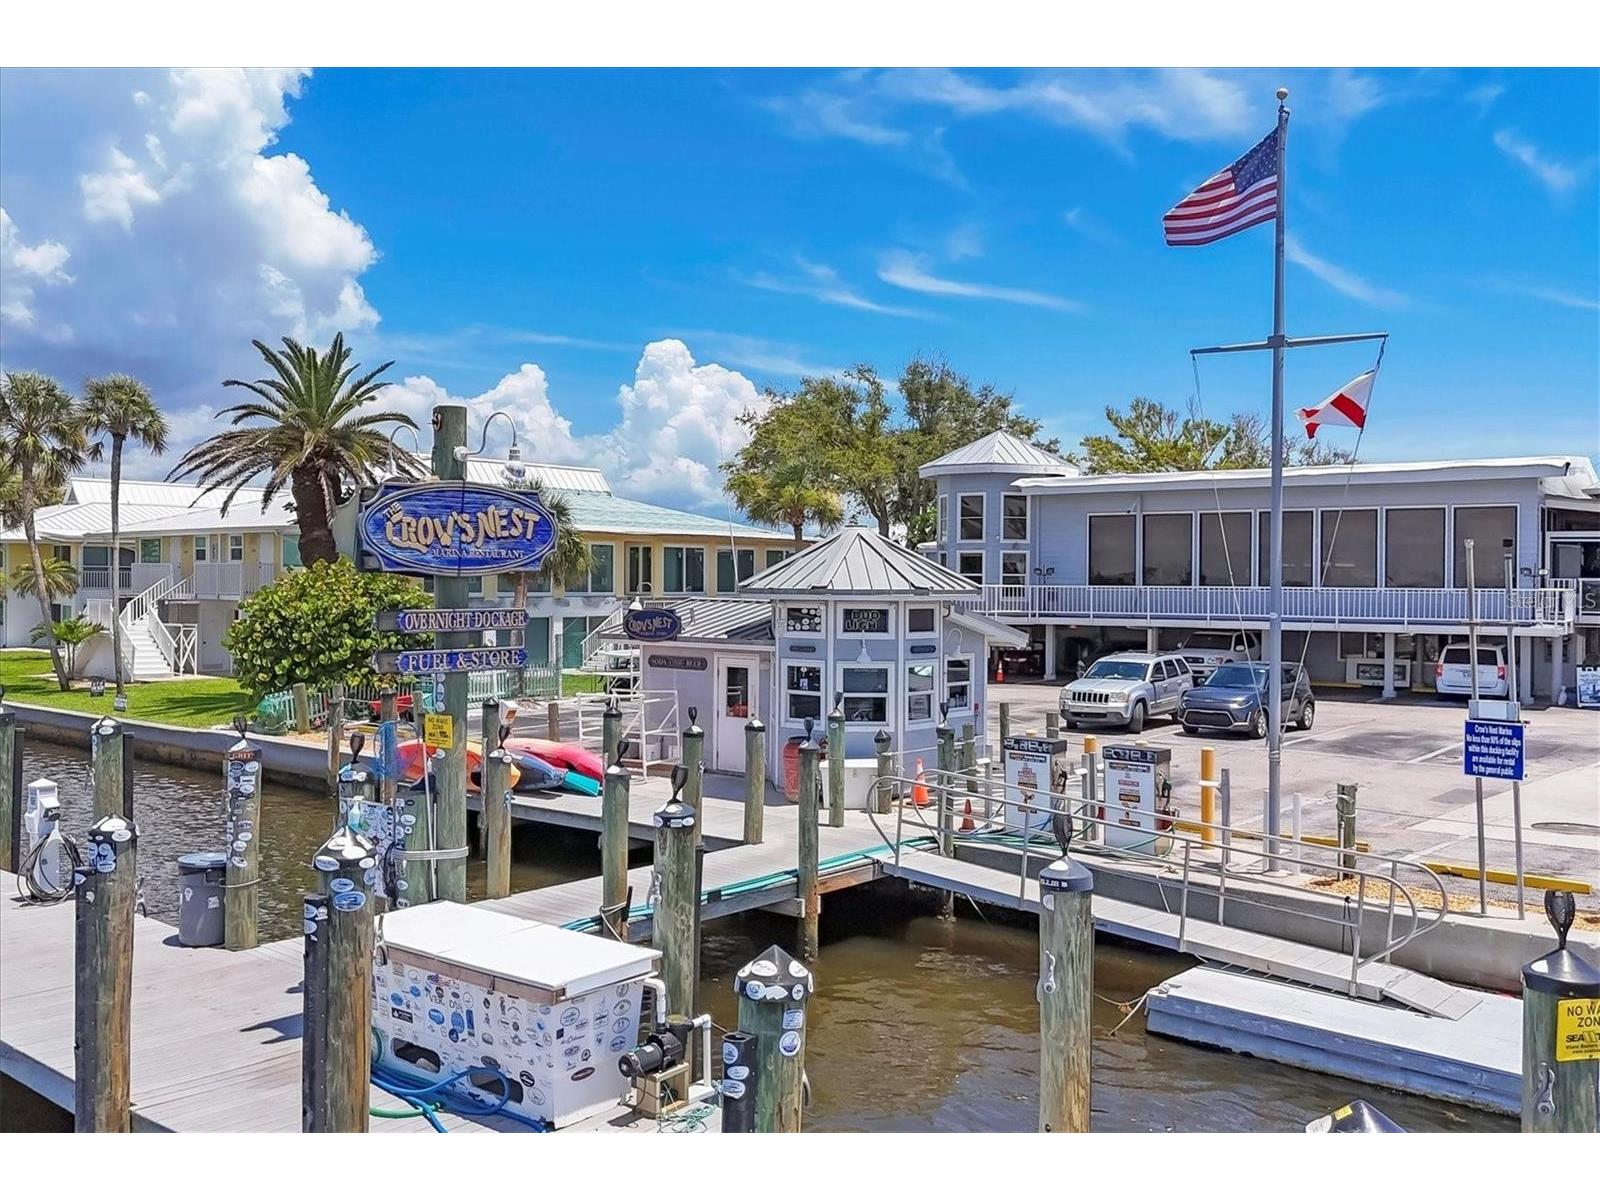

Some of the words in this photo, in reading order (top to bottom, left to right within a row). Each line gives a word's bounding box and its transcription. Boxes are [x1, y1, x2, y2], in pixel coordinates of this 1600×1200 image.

[383, 502, 401, 518] THE
[385, 510, 475, 554] CROW'S
[475, 504, 541, 549] NEST
[405, 611, 474, 630] OVERNIGHT
[475, 610, 526, 628] DOCKAGE
[652, 616, 673, 633] NEST
[409, 653, 452, 671] FUEL
[457, 653, 468, 669] &
[471, 650, 521, 666] STORE
[1567, 1005, 1583, 1016] NO
[1566, 1033, 1585, 1043] SEA
